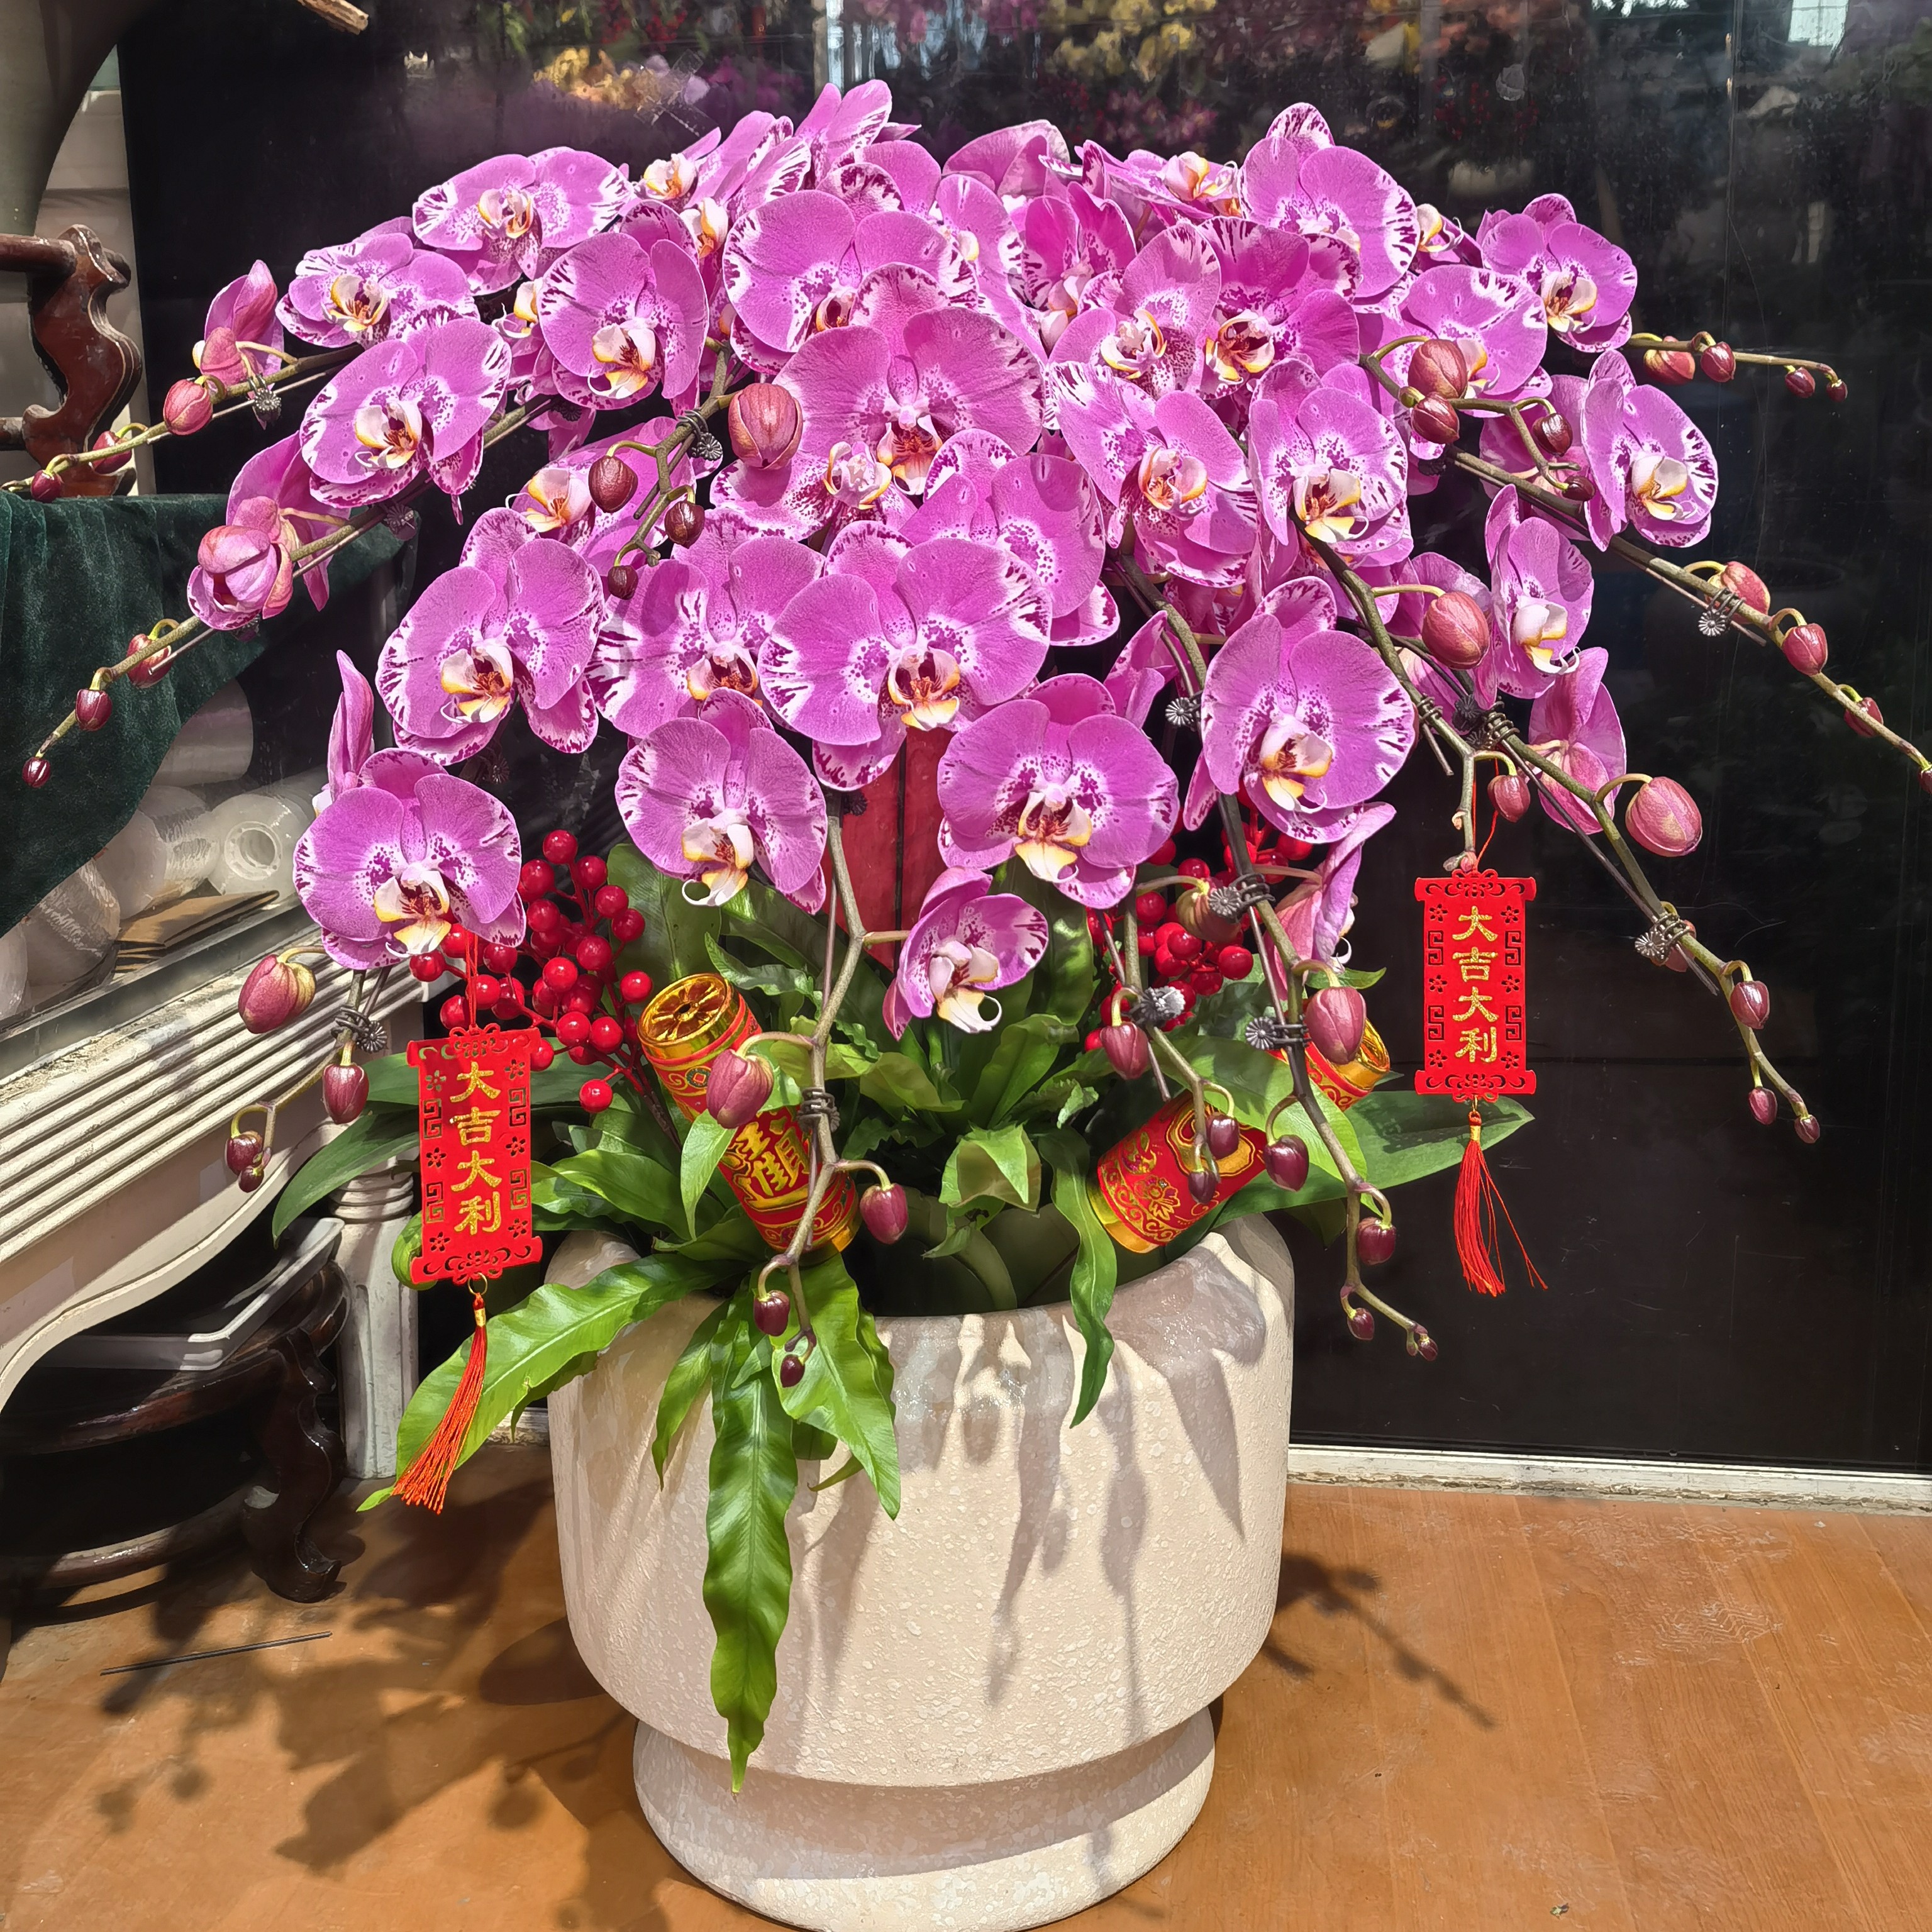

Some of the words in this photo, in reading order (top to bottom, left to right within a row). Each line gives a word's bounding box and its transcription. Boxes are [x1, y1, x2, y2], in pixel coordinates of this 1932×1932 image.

[1452, 905, 1499, 1063] 大吉大利
[449, 1061, 502, 1235] 大吉大利
